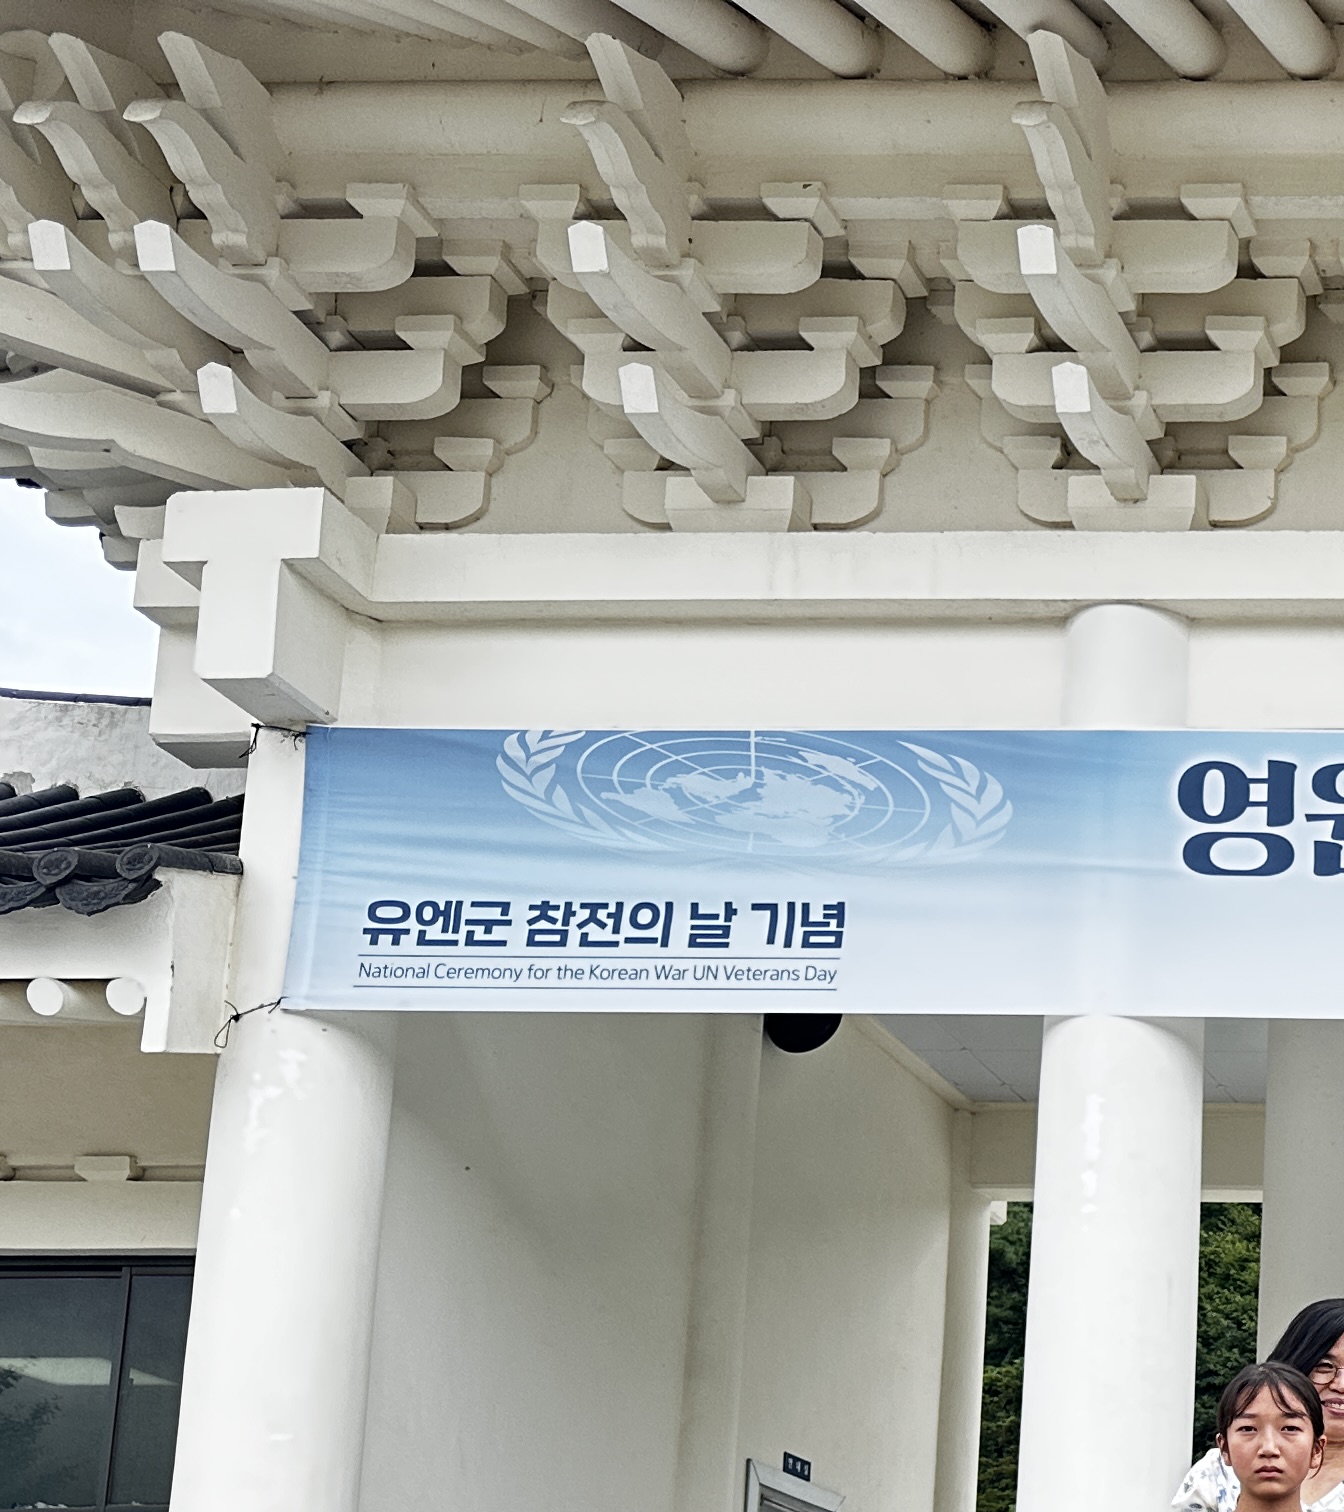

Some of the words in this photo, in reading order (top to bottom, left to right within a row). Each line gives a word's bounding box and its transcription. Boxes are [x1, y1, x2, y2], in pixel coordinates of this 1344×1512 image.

[361, 899, 514, 948] 유엔군
[525, 899, 675, 950] 참전의
[687, 900, 738, 950] 날
[750, 900, 846, 950] 기념
[357, 961, 431, 980] National
[433, 962, 524, 983] Ceremony
[527, 963, 553, 981] for
[556, 964, 586, 981] the
[588, 964, 650, 981] Korean
[653, 964, 690, 981] War
[692, 965, 719, 981] UN
[723, 964, 801, 982] Veterans
[803, 965, 838, 985] Day
